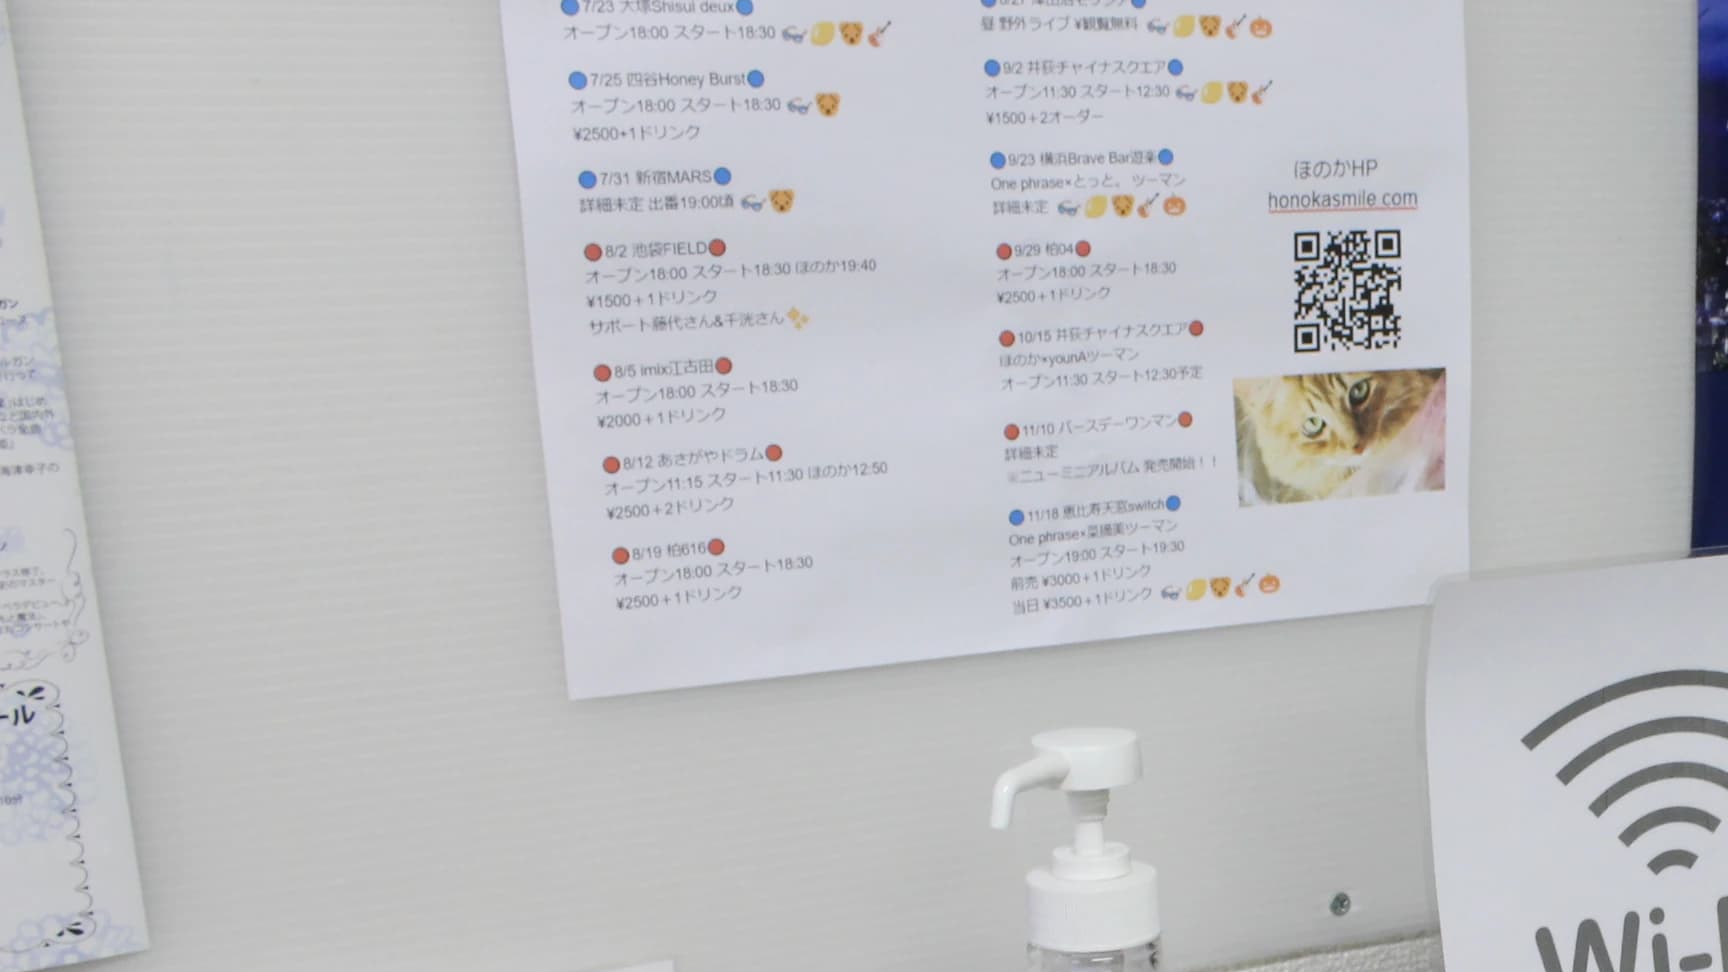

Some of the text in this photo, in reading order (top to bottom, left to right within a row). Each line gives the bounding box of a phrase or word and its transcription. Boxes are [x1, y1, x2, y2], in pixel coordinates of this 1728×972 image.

[564, 25, 776, 41] オープン18:00 スタート18:30
[1003, 61, 1024, 76] 9/2
[590, 73, 622, 88] 7/25
[709, 71, 746, 86] Burst
[571, 97, 781, 115] オープン18:00 スタート18:30
[1008, 153, 1036, 167] 9/23
[1294, 158, 1379, 179] ほのかHP
[600, 172, 630, 186] 7/31
[990, 177, 1017, 191] One
[1268, 189, 1419, 210] honokasmile.com
[605, 242, 708, 258] 8/2 池袋FIELD
[1014, 244, 1042, 258] 9/29
[585, 266, 688, 285] オープン18:00
[693, 263, 792, 279] スタート18:30
[997, 262, 1178, 282] オープン18:00 スタート18:30
[1019, 330, 1053, 344] 10/15
[614, 364, 637, 379] 8/5
[597, 379, 800, 404] オープン18:00 スタート18:30
[1022, 424, 1055, 438] 11/10
[622, 456, 655, 471] 8/12
[1027, 507, 1061, 522] 11/18
[1008, 533, 1036, 547] One
[632, 546, 663, 561] 8/19
[614, 555, 815, 588] オープン18:00 スタート18:30
[1013, 598, 1040, 616] 当日
